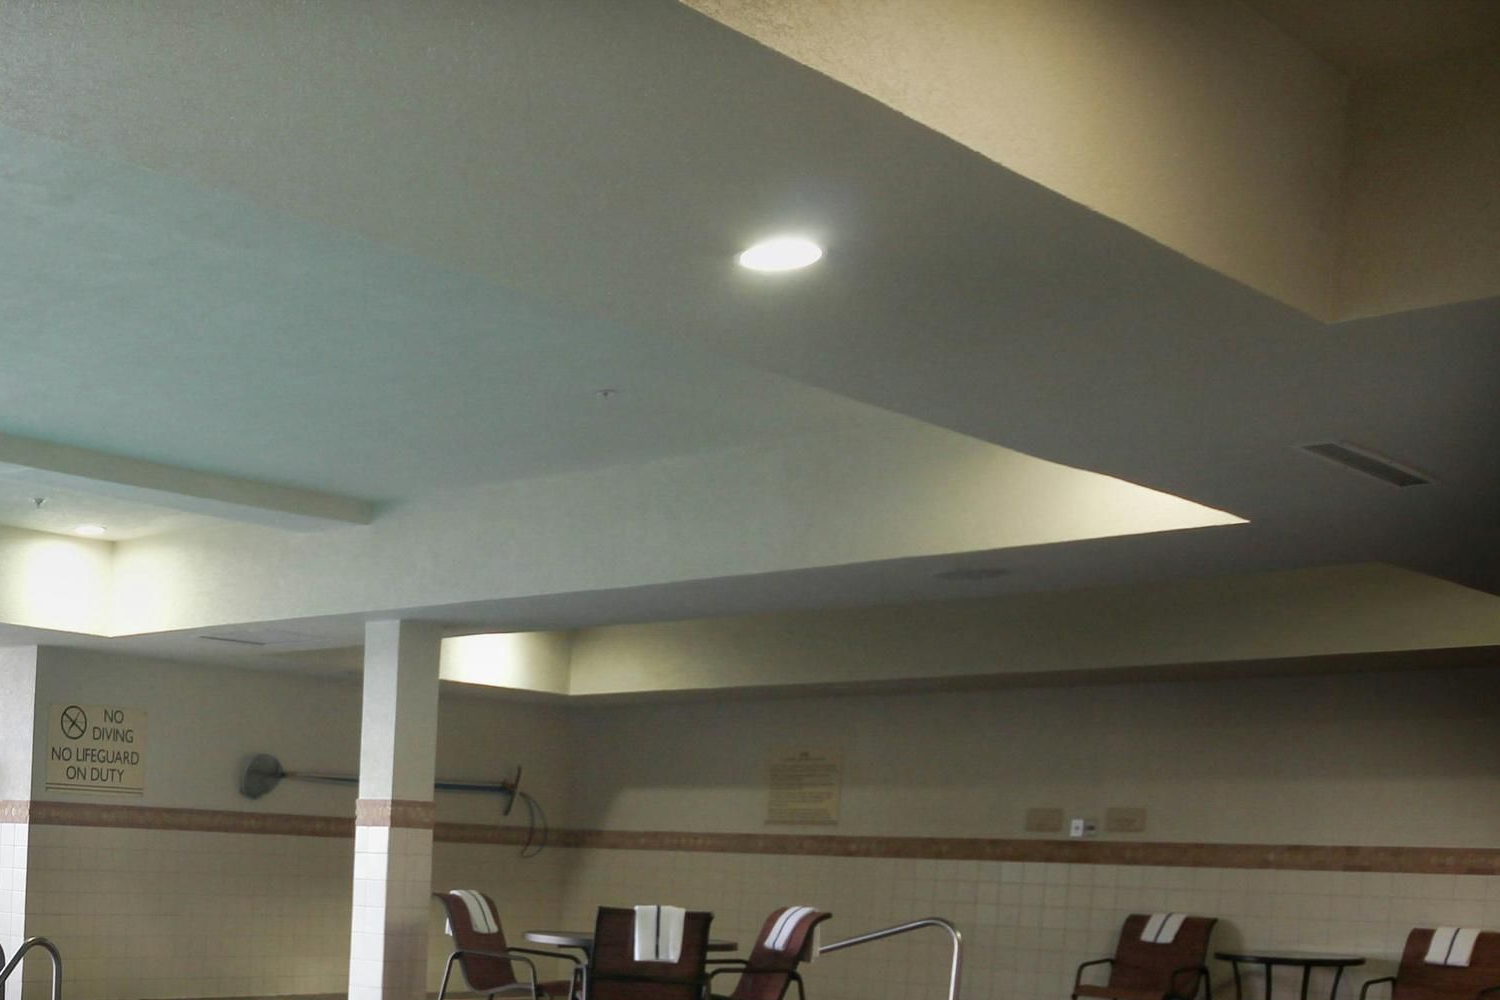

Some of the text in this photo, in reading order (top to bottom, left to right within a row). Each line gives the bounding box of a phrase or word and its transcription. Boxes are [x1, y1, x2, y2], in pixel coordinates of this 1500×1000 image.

[103, 708, 125, 724] NO
[92, 726, 134, 744] DIVING
[51, 746, 140, 766] NO LIFEGUARD
[65, 765, 125, 783] ON DUTY
